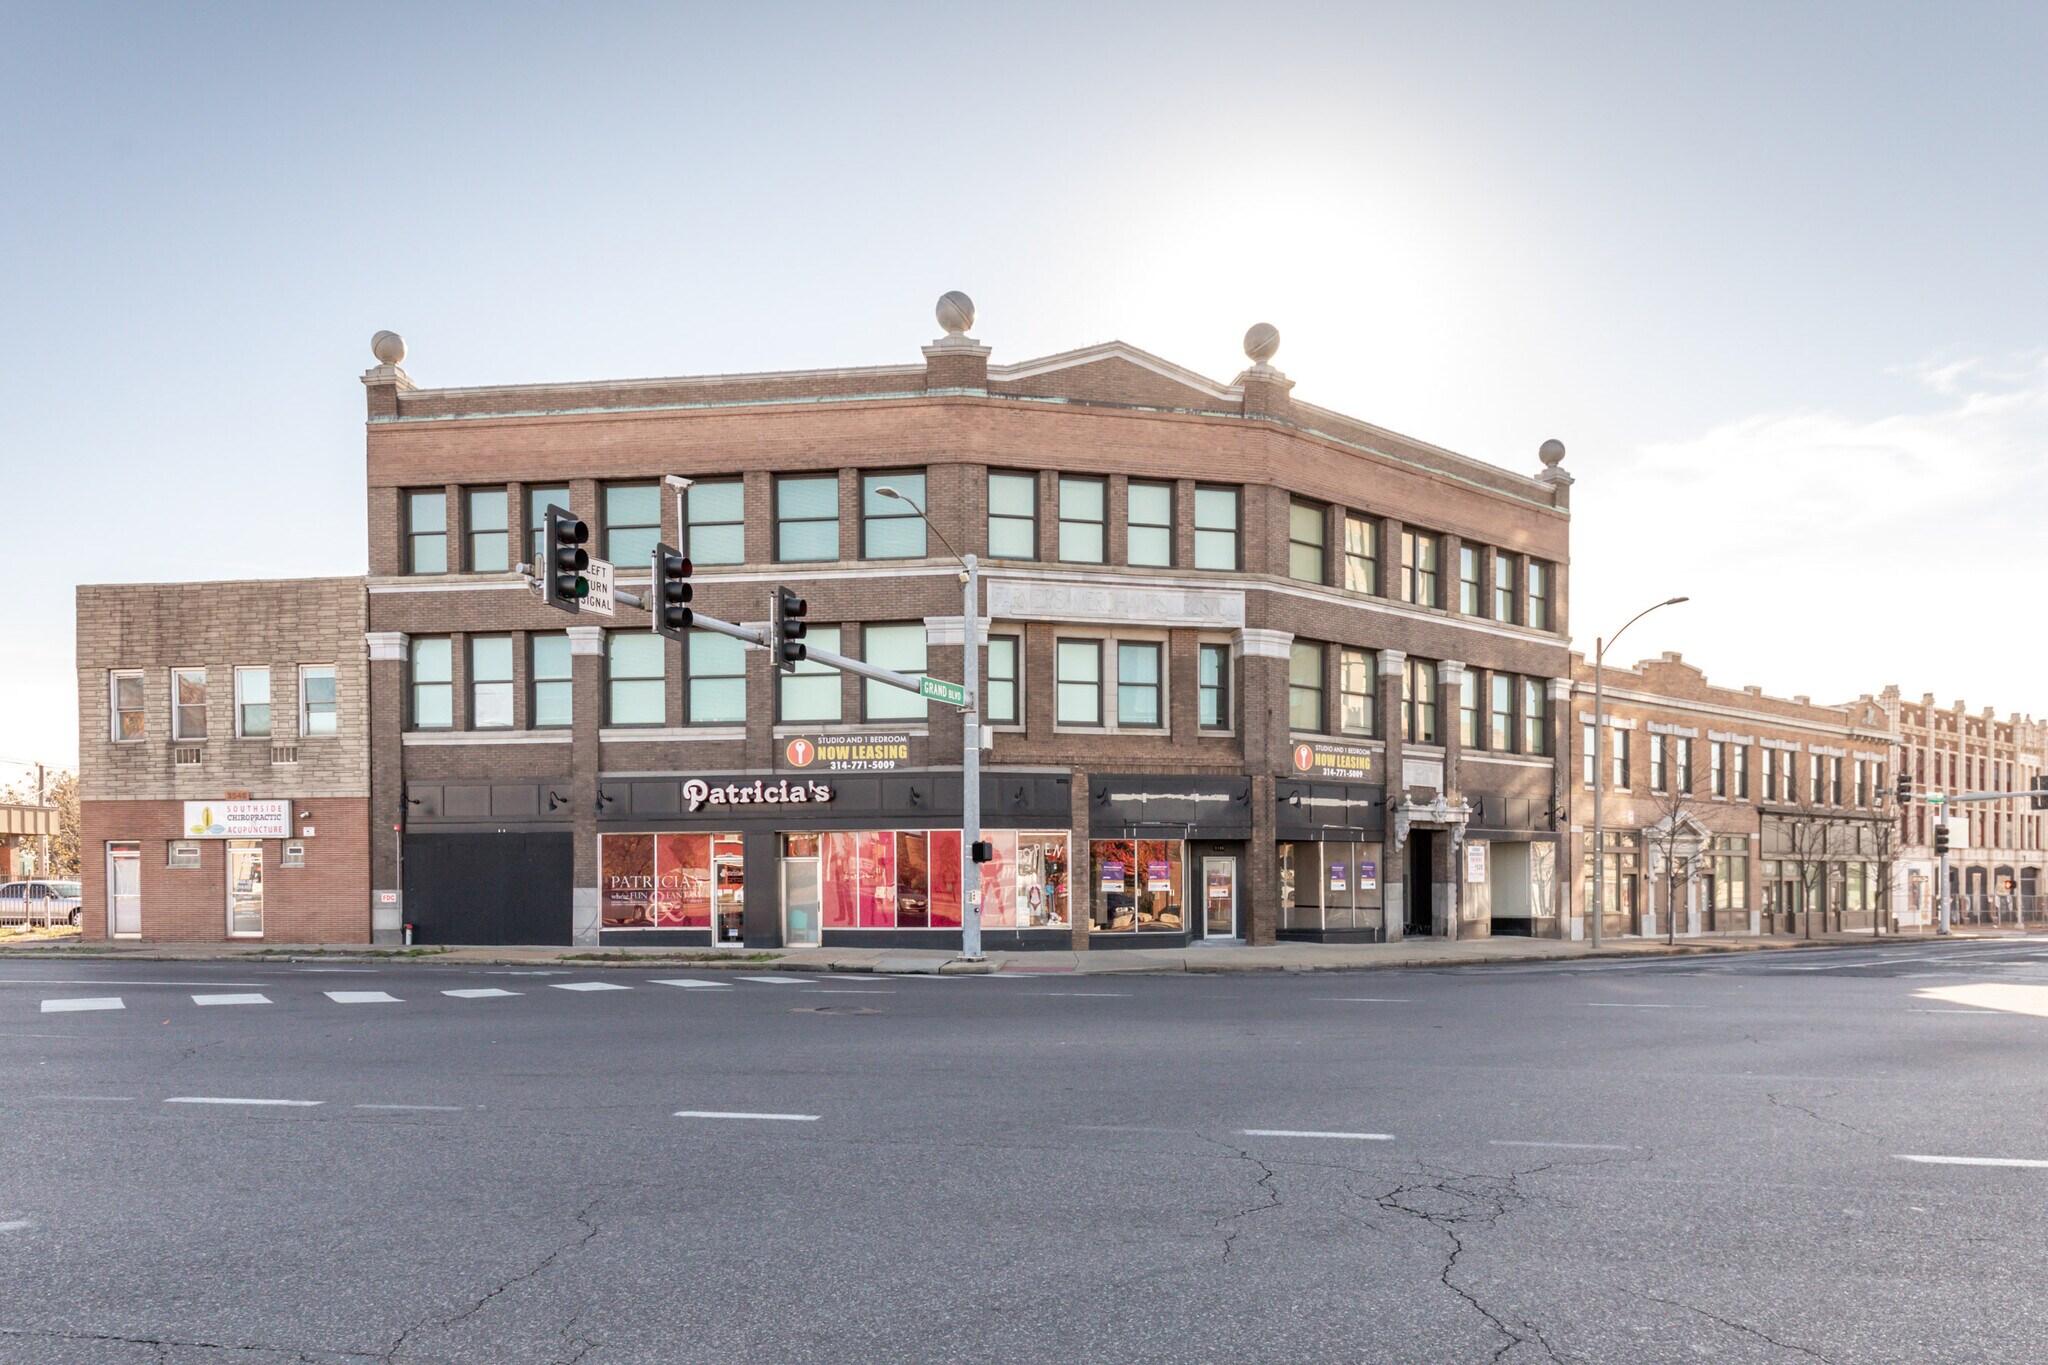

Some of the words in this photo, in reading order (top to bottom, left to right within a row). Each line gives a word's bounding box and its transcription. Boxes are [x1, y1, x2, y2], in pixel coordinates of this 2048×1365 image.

[924, 681, 947, 698] GRAND
[948, 689, 961, 700] BLVD
[818, 736, 845, 745] STUDIO
[846, 735, 863, 744] AND
[869, 735, 907, 743] BEDROOM
[817, 746, 850, 760] NOW
[852, 745, 908, 760] LEASING
[830, 761, 895, 770] 314-771-5009
[1315, 753, 1335, 766] NOW
[1337, 755, 1370, 769] LEASING
[1323, 768, 1363, 777] 314-771-5009
[683, 779, 831, 812] Patricia's
[226, 805, 283, 813] SOUTHSIDE
[611, 875, 702, 888] PATRICIA'S
[629, 891, 648, 900] FUN
